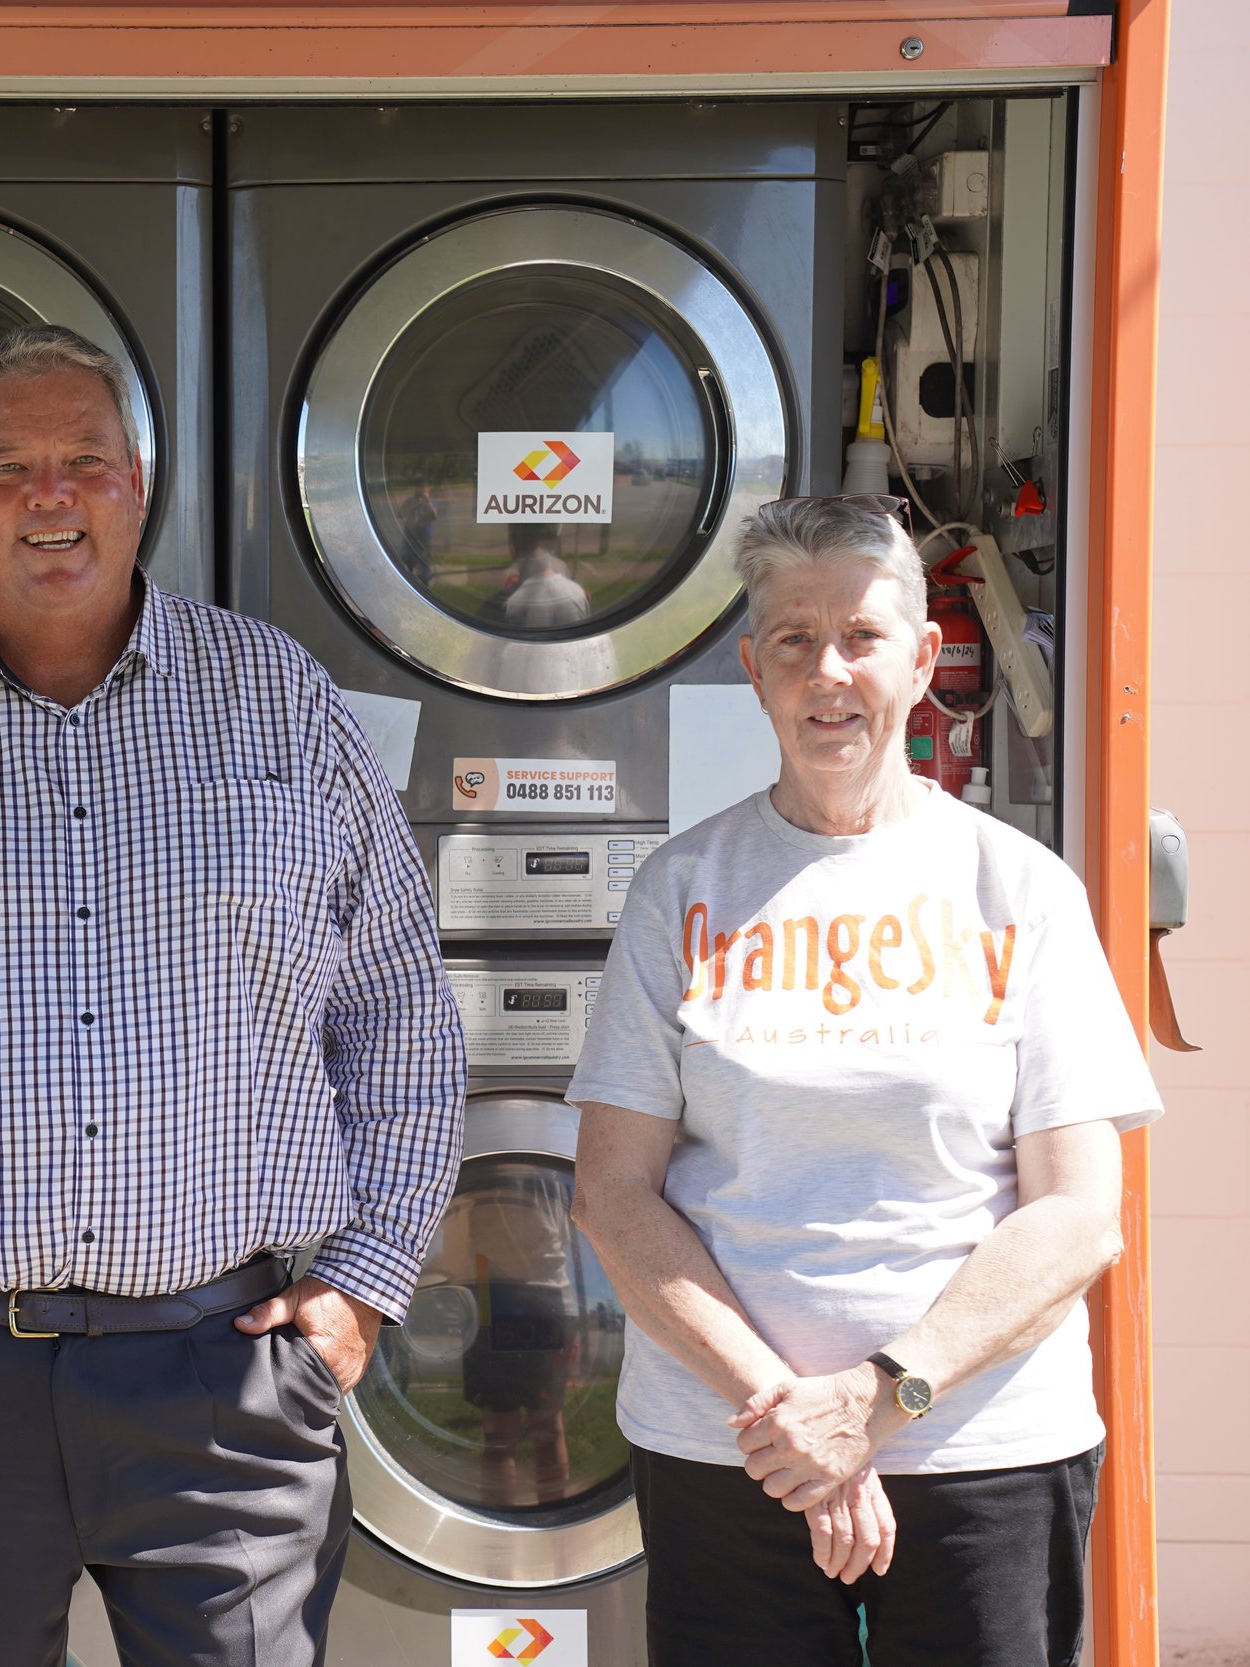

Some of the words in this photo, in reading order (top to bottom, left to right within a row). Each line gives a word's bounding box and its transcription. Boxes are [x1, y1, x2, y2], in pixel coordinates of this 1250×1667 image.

[483, 494, 601, 515] AURIZON
[506, 770, 556, 780] SERVICE
[559, 771, 614, 782] SUPPORT
[506, 783, 549, 800] 0488
[553, 783, 581, 801] 851
[587, 784, 614, 801] 113
[682, 892, 1016, 1026] OrangeSky
[735, 1022, 941, 1045] Australia
